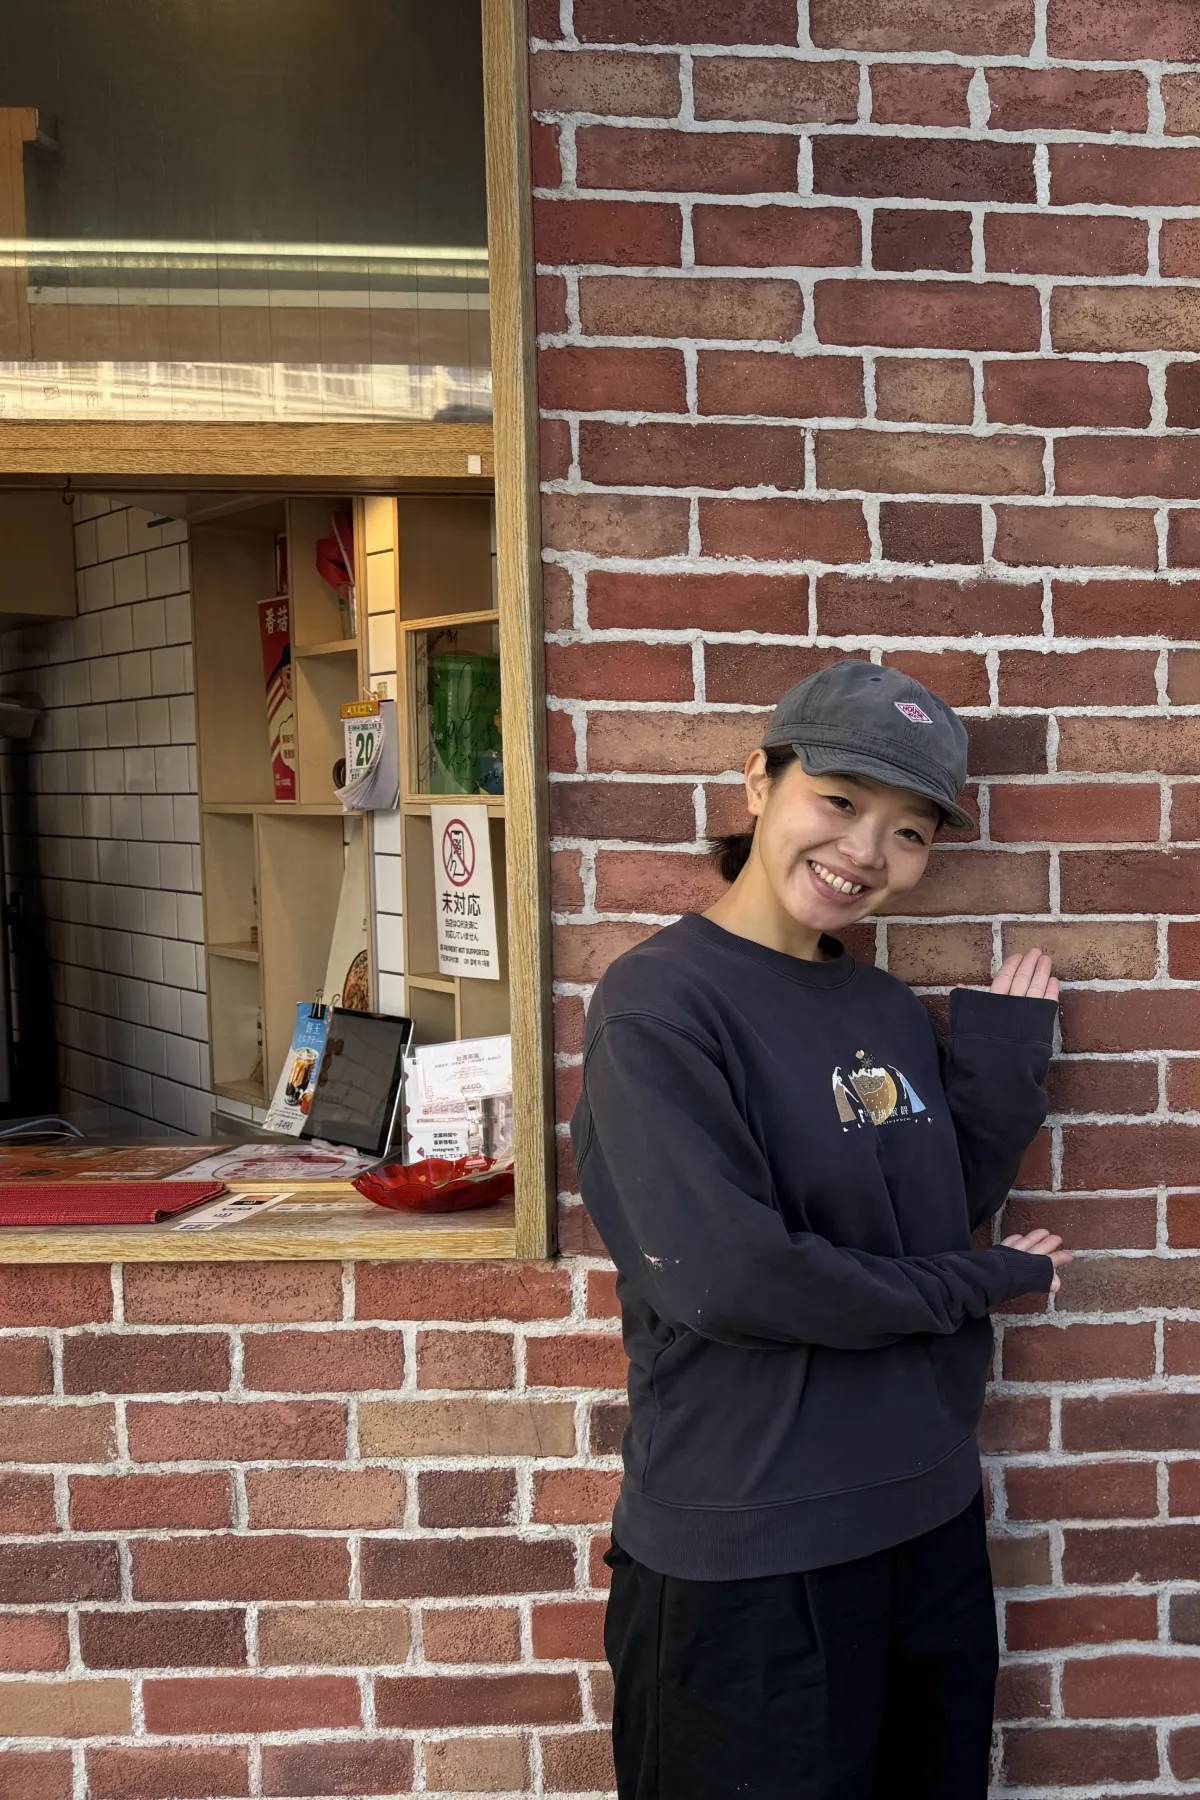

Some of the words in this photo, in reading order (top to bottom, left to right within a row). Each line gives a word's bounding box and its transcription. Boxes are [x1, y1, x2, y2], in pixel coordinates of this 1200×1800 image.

[356, 733, 375, 767] 20
[442, 891, 481, 916] 未対応
[445, 930, 479, 941] 対応していません
[466, 948, 490, 957] SUPPORTED
